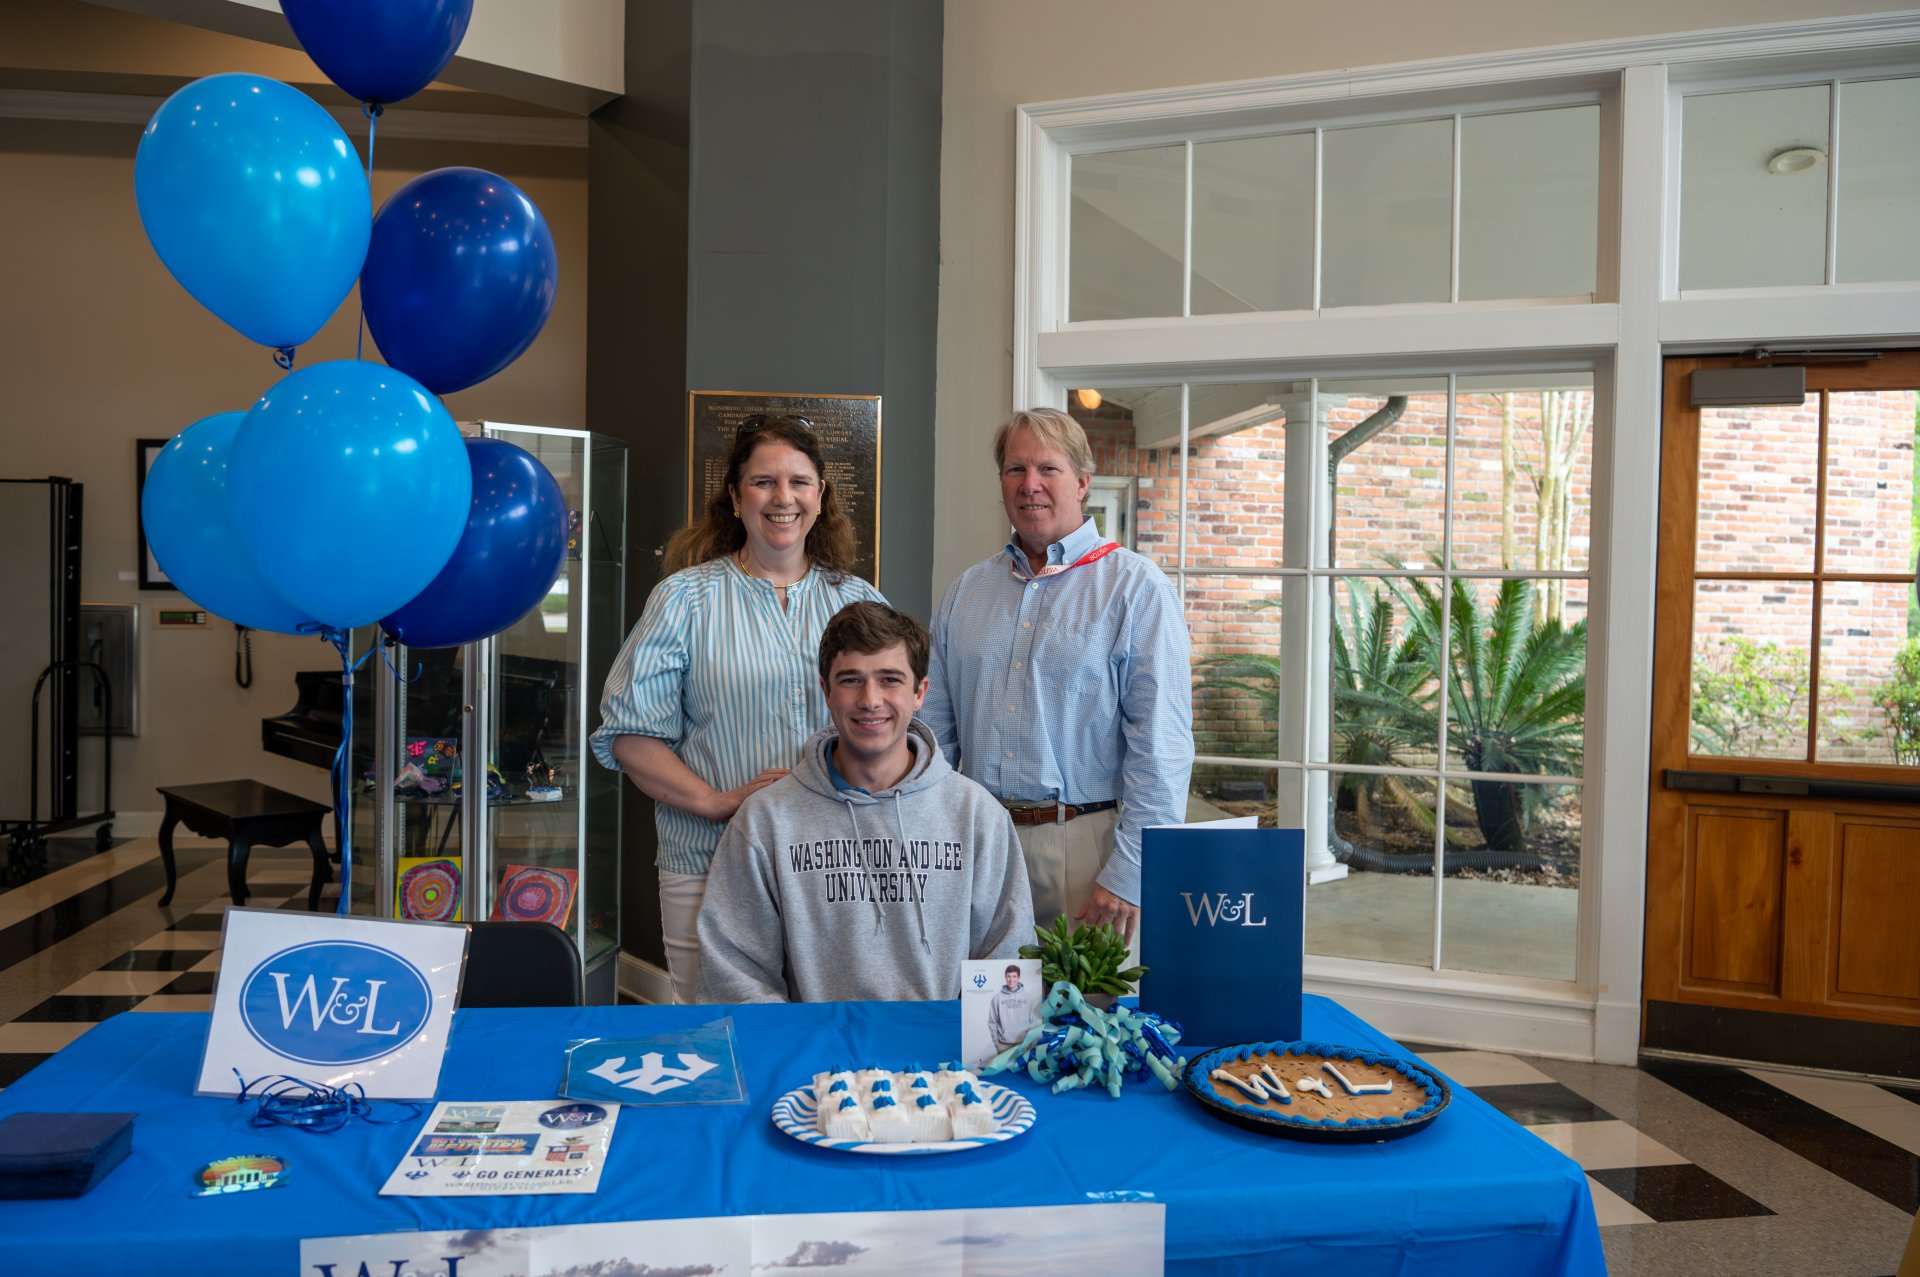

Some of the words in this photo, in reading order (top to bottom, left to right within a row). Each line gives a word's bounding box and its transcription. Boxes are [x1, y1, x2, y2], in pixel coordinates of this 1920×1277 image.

[789, 838, 893, 873] WASHINGTON
[898, 839, 930, 870] AND
[934, 840, 963, 871] LEE
[1180, 892, 1267, 927] W&L
[269, 972, 400, 1035] W&L
[1321, 1061, 1392, 1096] L
[545, 1111, 603, 1124] W&L
[477, 1170, 499, 1180] GO
[503, 1166, 591, 1180] GENERALS!
